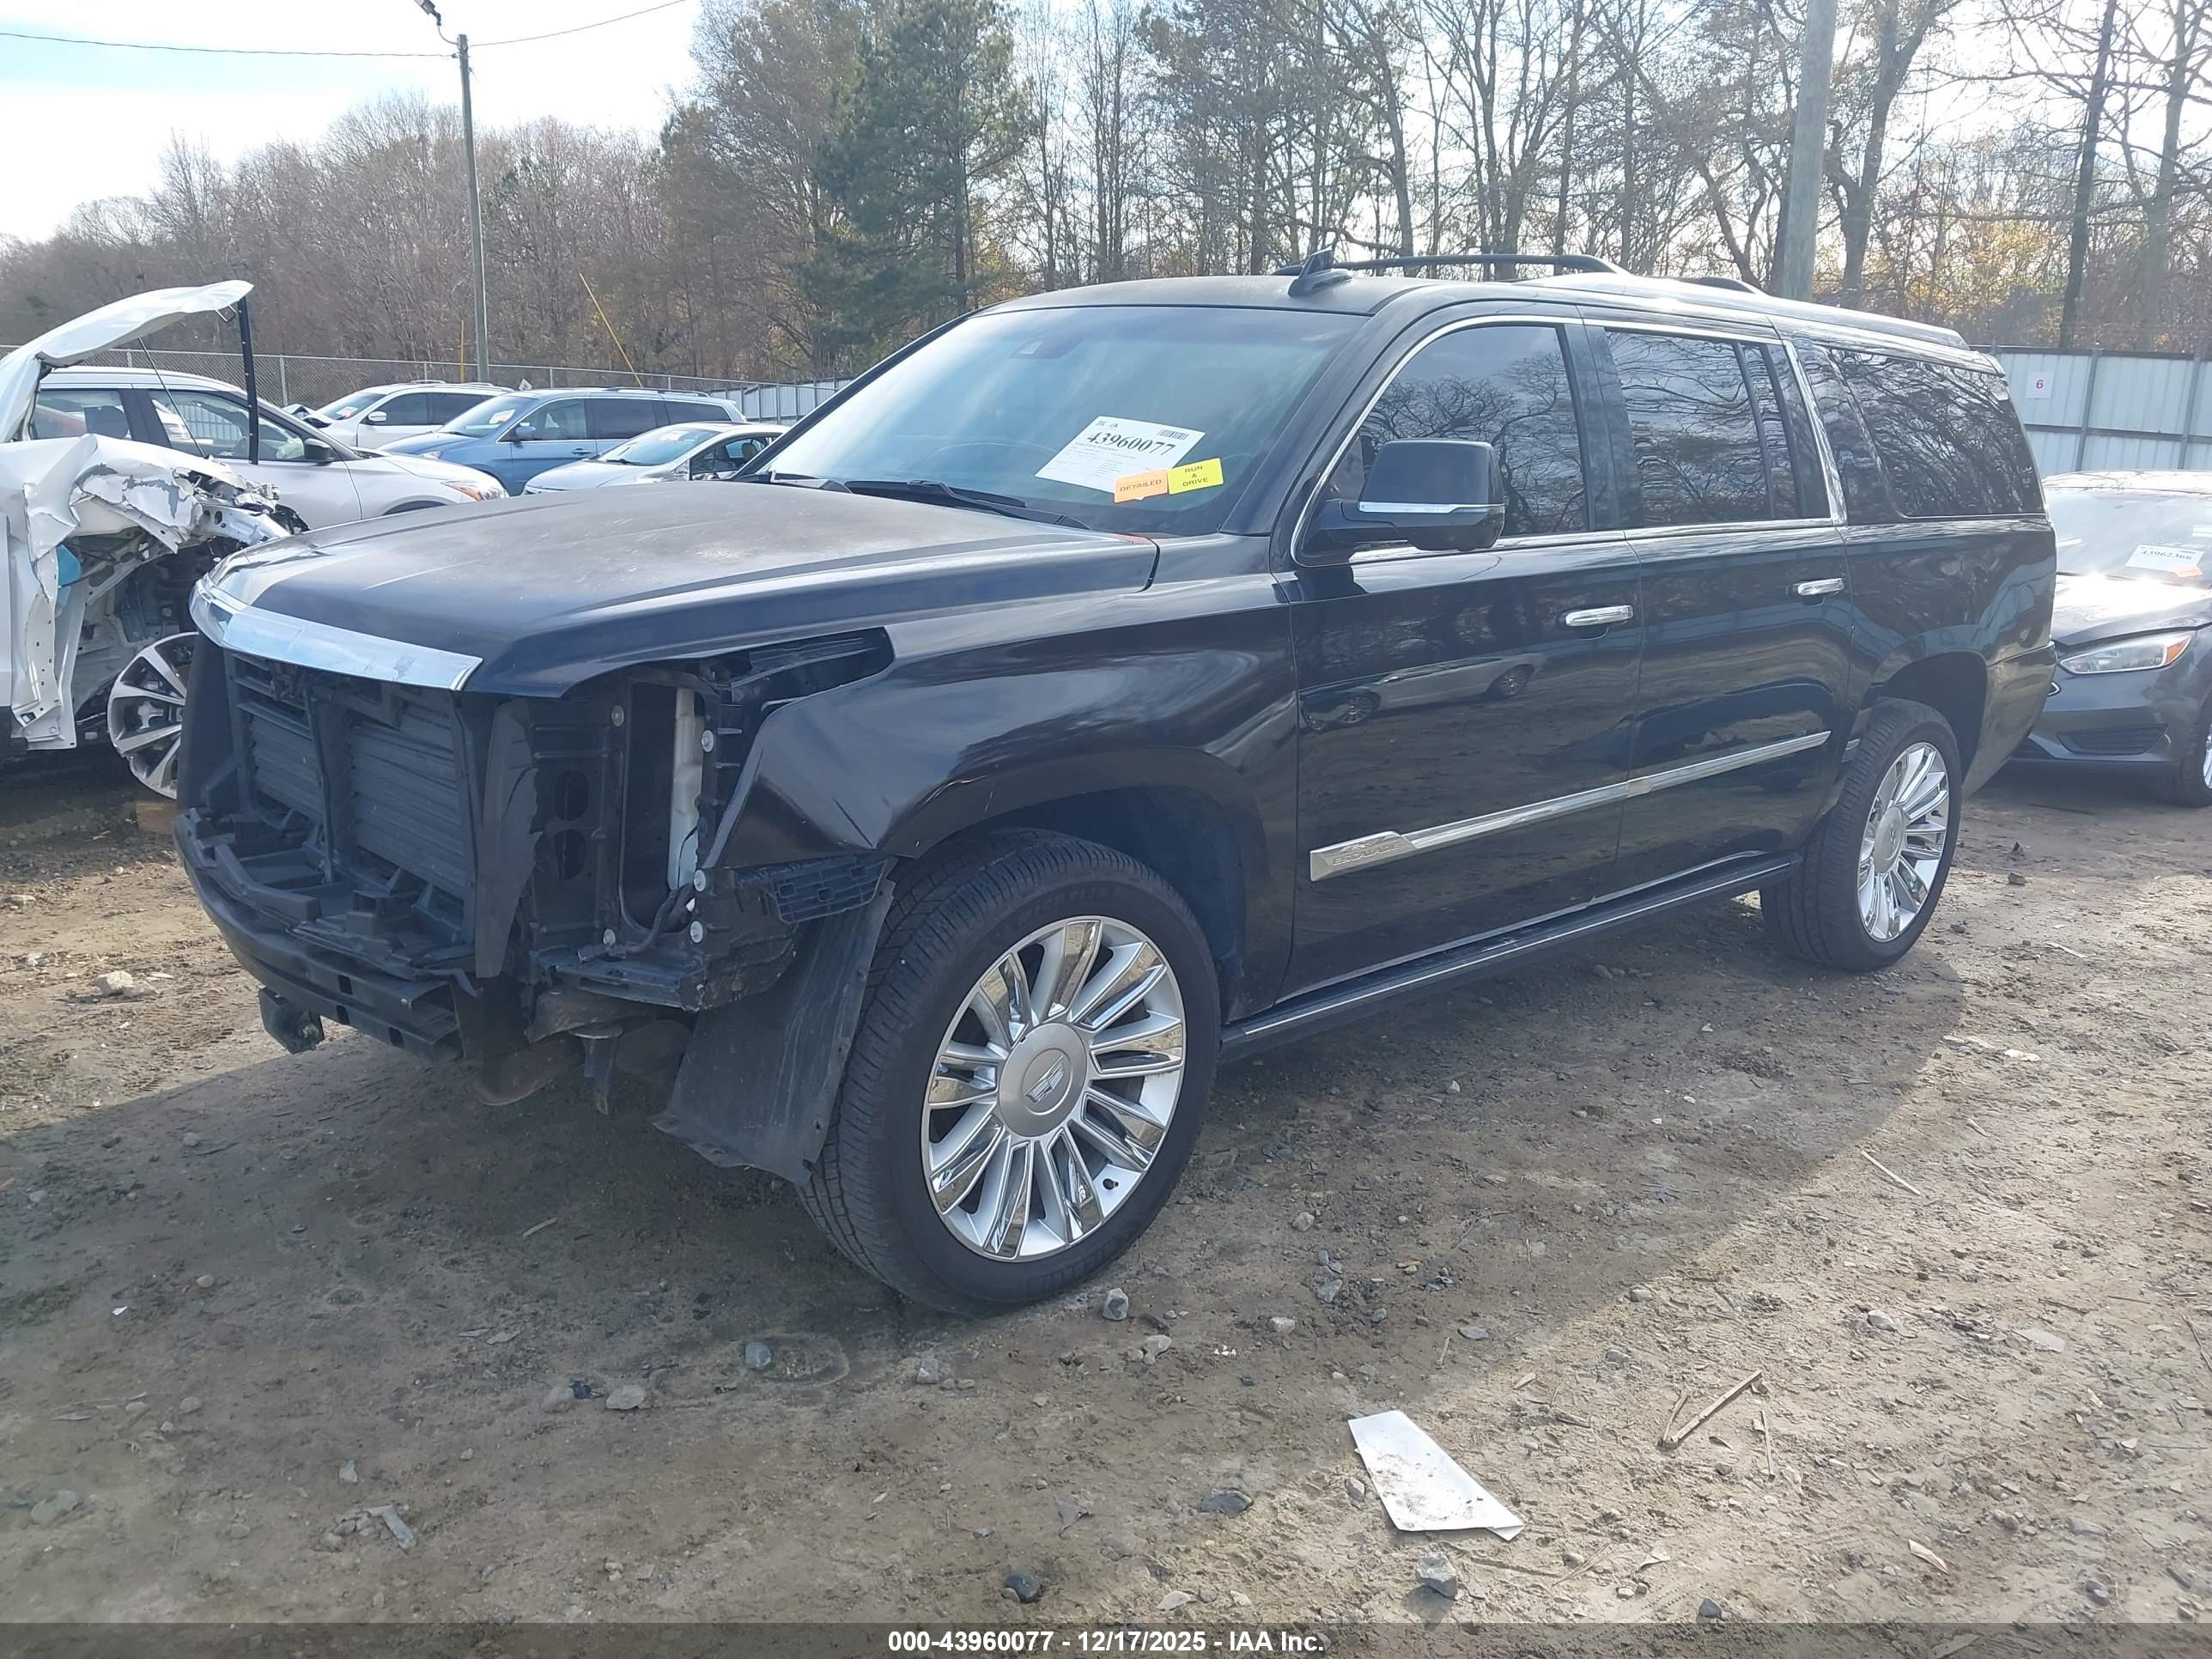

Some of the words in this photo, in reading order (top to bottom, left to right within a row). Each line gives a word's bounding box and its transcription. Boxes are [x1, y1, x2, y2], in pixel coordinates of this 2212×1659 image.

[2035, 379, 2044, 389] 6
[1086, 432, 1176, 456] 43960077
[1184, 465, 1203, 474] RUN
[1119, 478, 1162, 492] DETAILED
[1182, 477, 1208, 487] DRIVE
